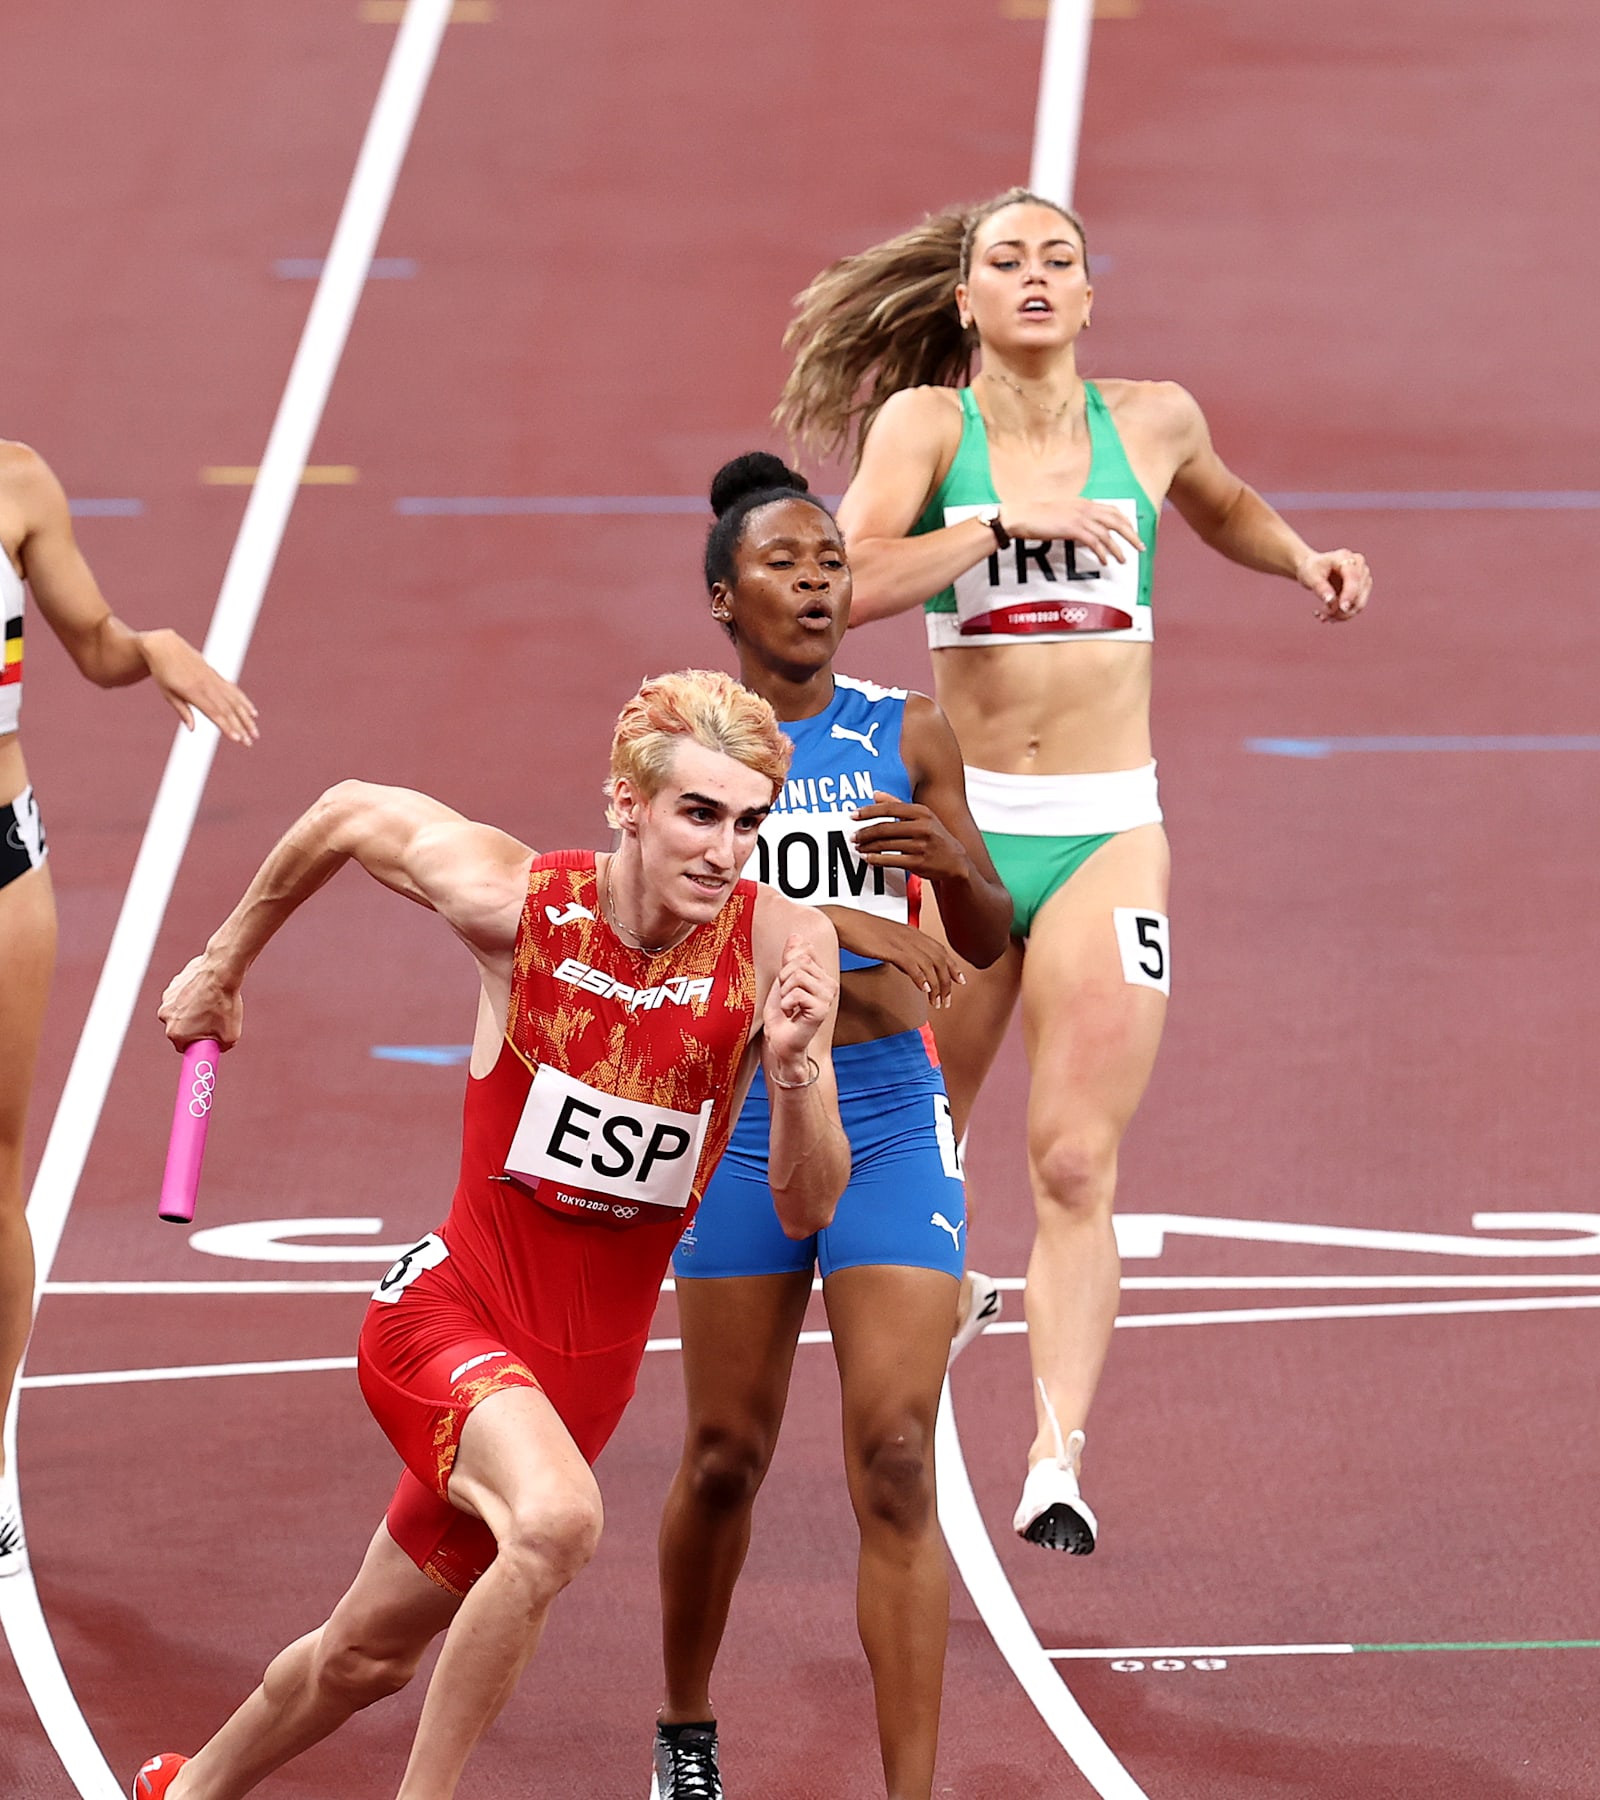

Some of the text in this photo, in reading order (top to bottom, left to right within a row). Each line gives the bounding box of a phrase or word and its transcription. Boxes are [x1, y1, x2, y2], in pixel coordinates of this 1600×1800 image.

[771, 771, 875, 811] INICAN
[1135, 916, 1164, 980] 5
[552, 957, 715, 1013] ESPAÑA
[545, 1095, 691, 1183] ESP
[556, 1191, 609, 1212] TOKYO 2020
